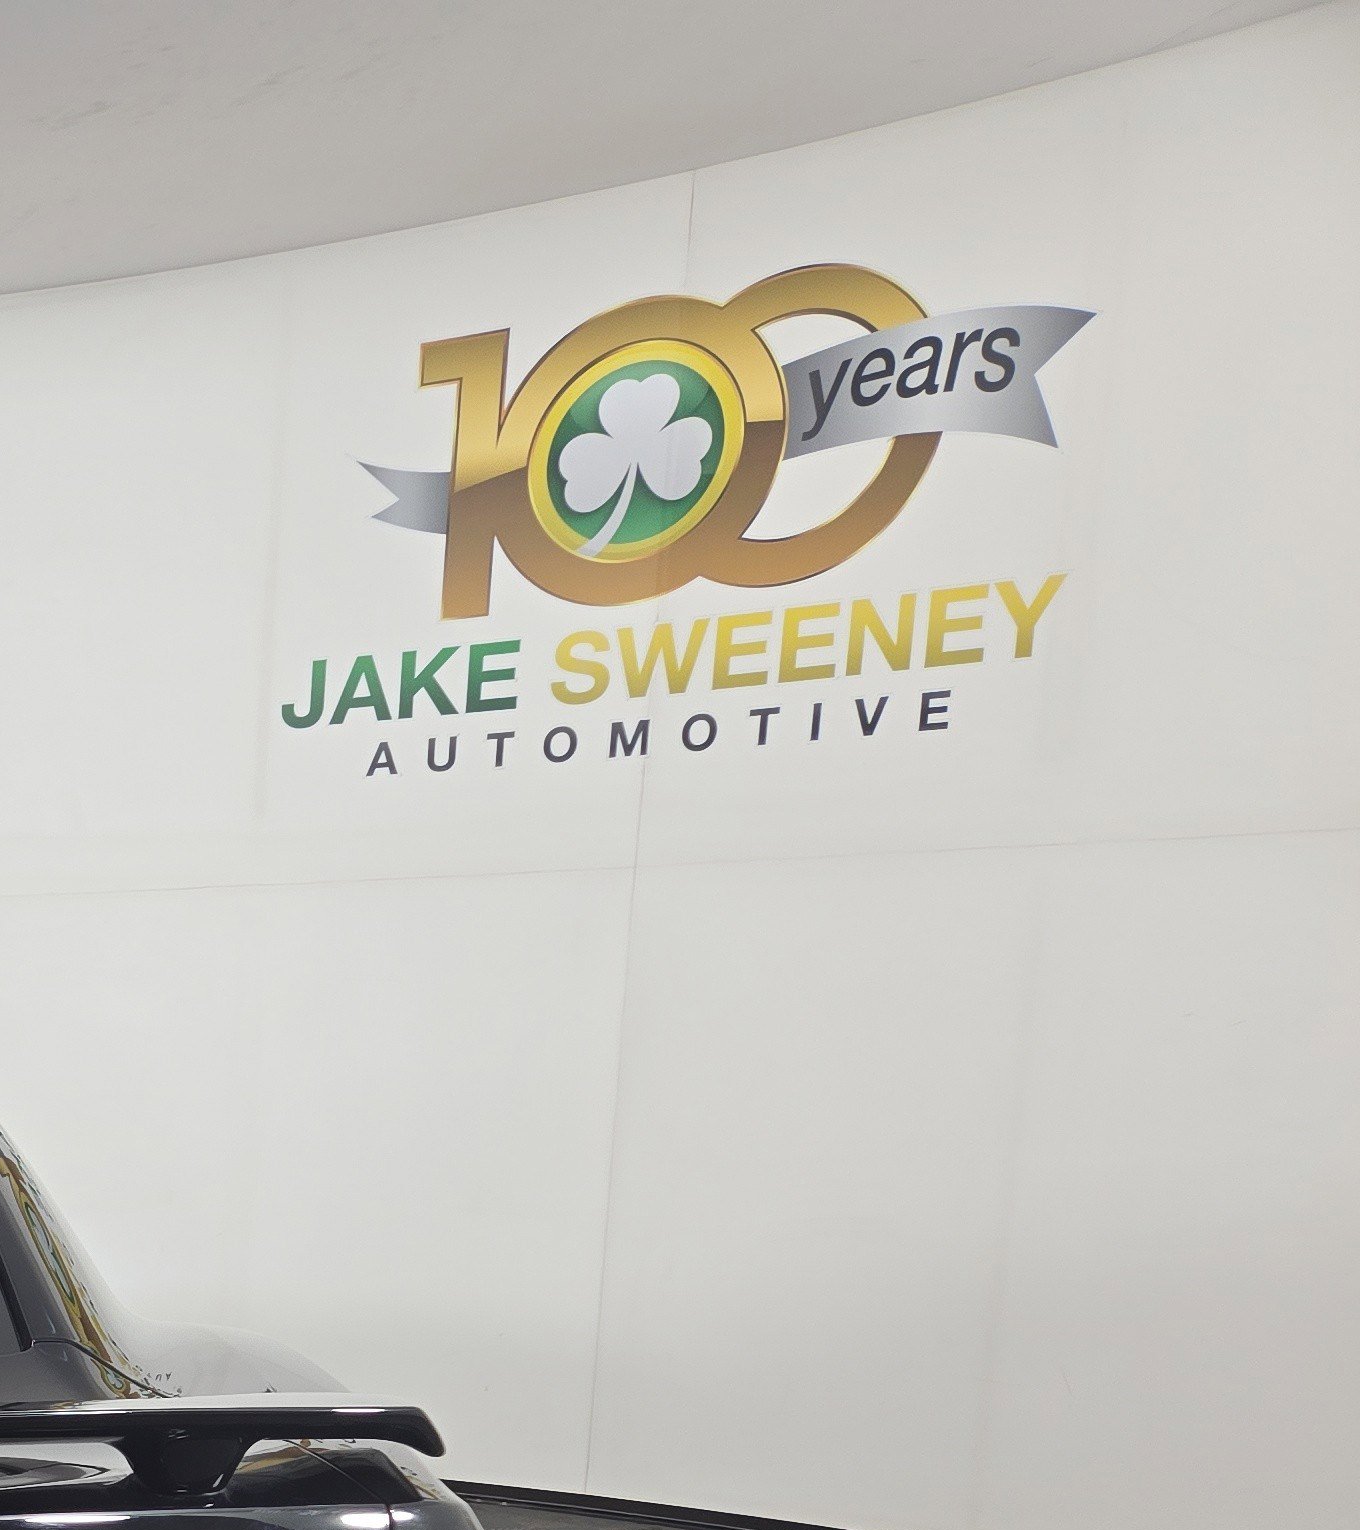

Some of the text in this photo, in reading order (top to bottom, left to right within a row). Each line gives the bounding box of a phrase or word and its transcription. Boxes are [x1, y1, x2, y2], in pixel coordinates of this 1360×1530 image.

[799, 323, 1022, 442] years
[281, 573, 1069, 730] JAKE SWEENEY
[365, 689, 953, 777] AUTOMOTIVE
